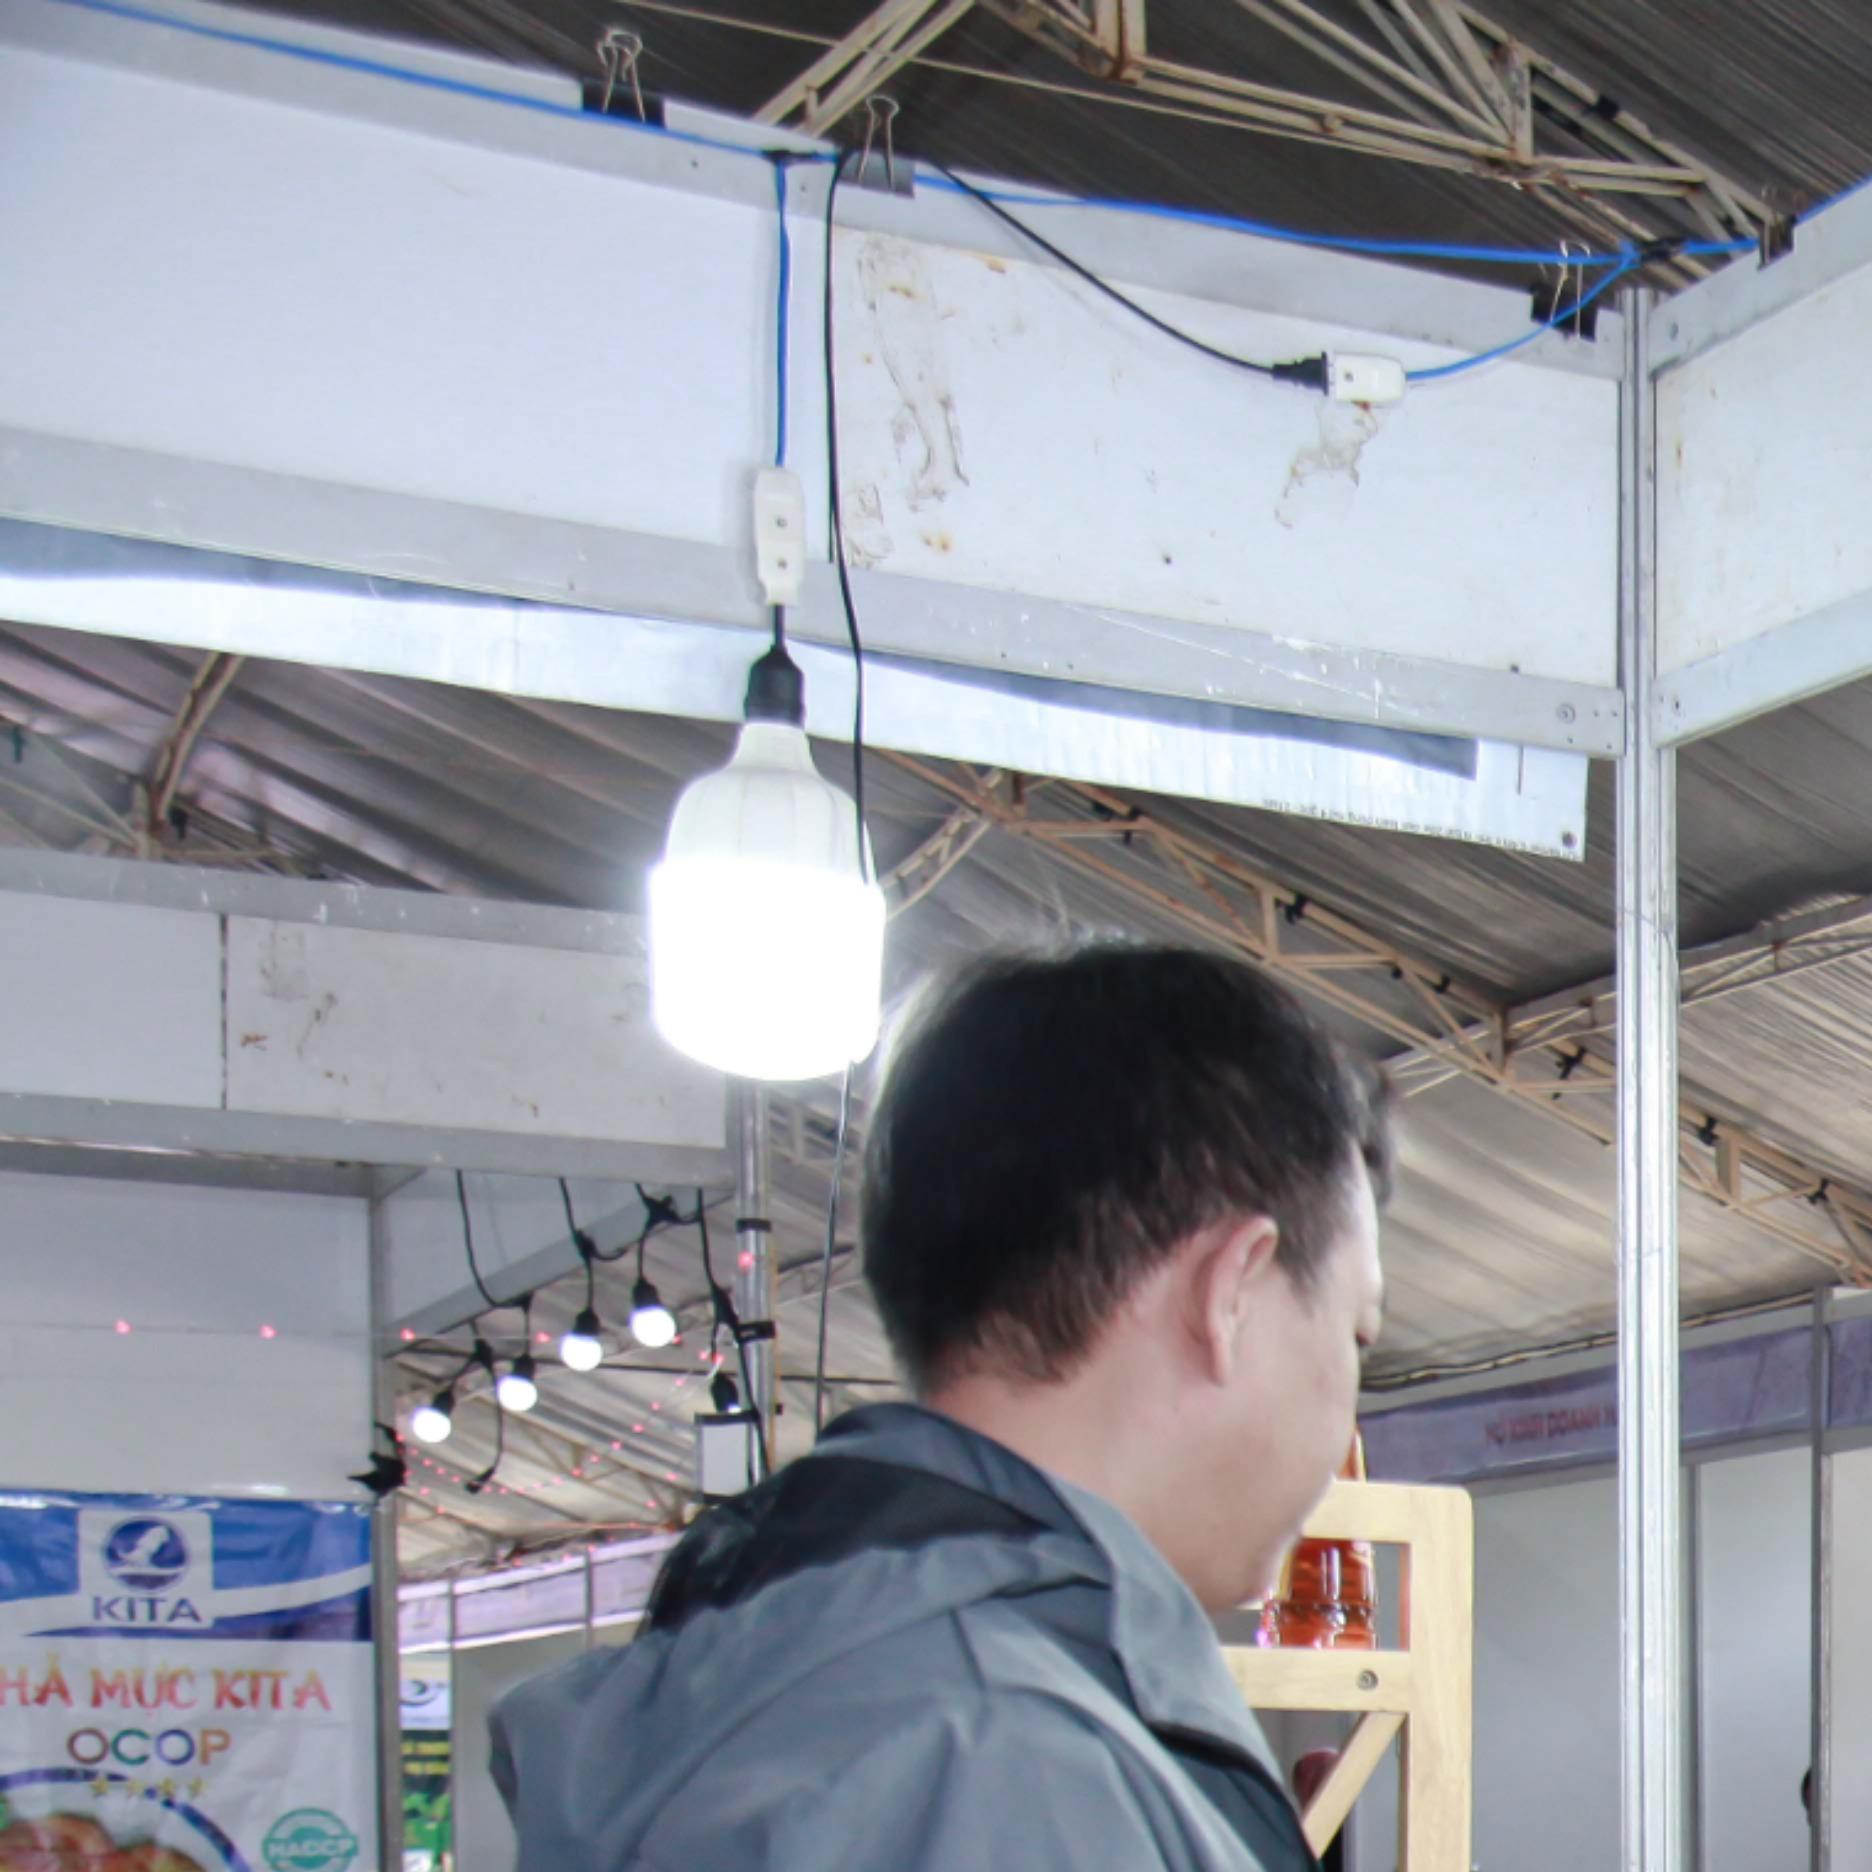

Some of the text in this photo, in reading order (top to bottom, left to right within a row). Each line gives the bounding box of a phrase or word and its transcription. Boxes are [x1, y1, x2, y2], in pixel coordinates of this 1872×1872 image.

[93, 1595, 203, 1623] KITA
[90, 1661, 199, 1719] MỰC
[213, 1666, 333, 1712] KITA
[66, 1728, 232, 1766] OCOP
[267, 1838, 355, 1858] HACCP
